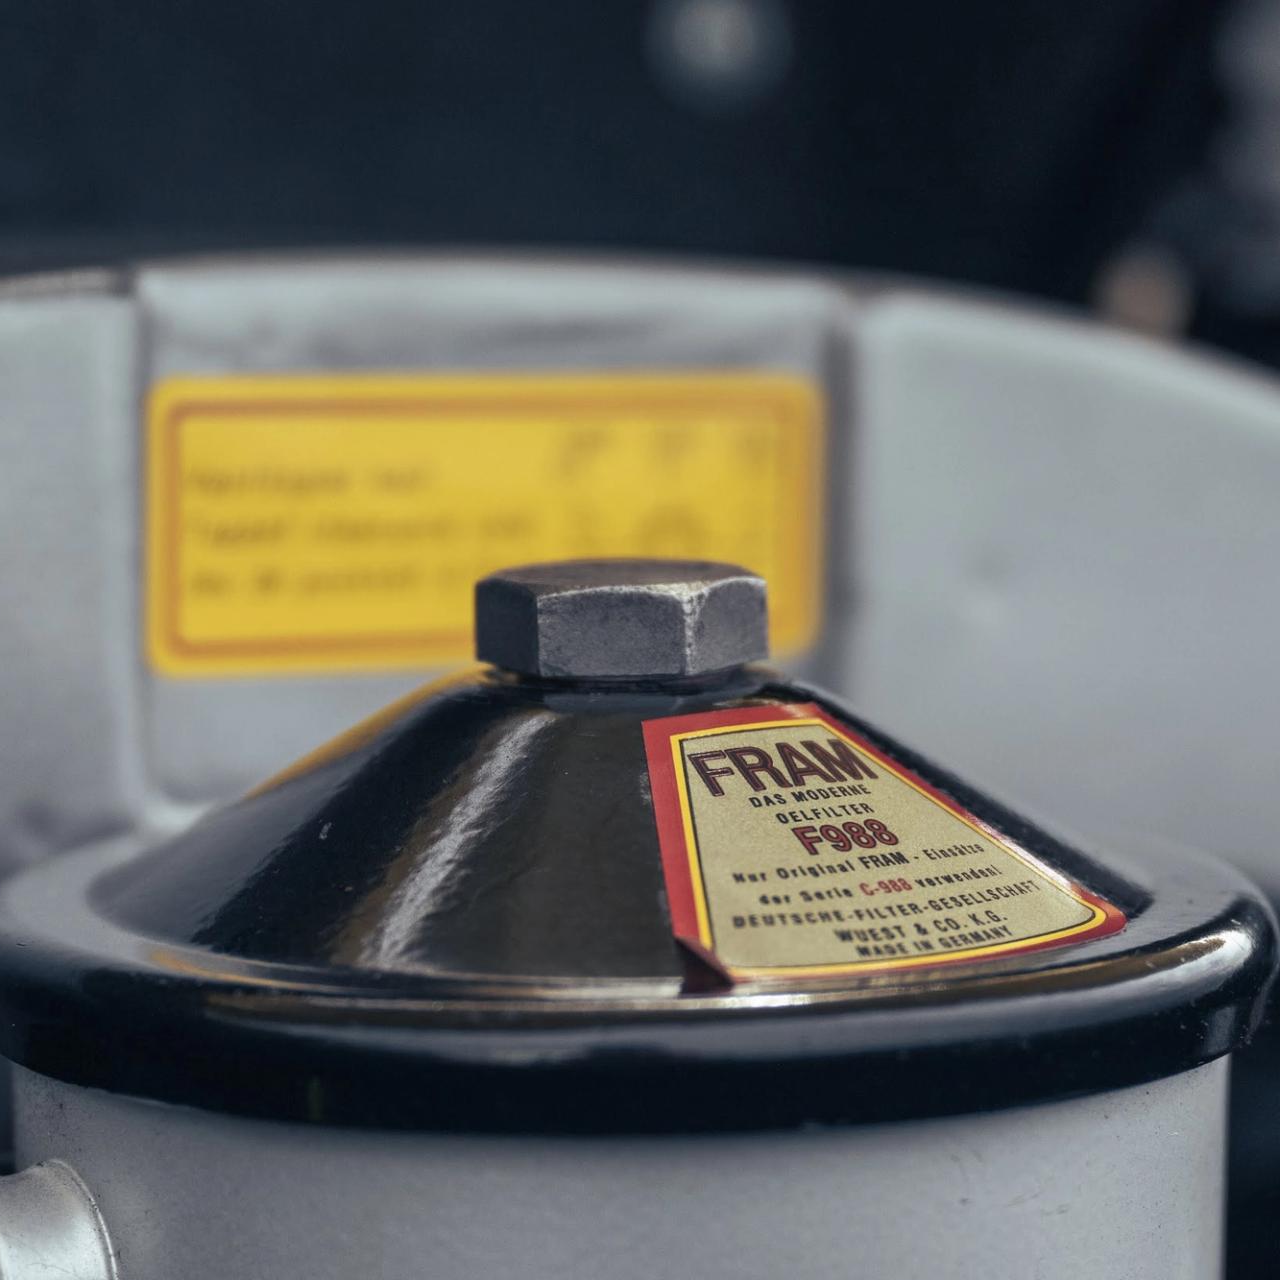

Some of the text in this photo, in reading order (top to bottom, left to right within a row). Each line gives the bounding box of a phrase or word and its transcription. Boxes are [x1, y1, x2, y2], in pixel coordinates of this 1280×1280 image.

[688, 739, 879, 797] FRAM
[749, 784, 872, 808] DAS MODERNE
[776, 802, 875, 825] OELFILTER
[791, 818, 899, 855] F988
[776, 859, 856, 880] Original
[858, 851, 910, 870] FRAM
[922, 843, 985, 861] Einsätze
[799, 887, 854, 903] Serie
[859, 878, 913, 897] C-988
[834, 924, 906, 942] WUEST
[913, 923, 929, 936] &
[933, 917, 968, 933] CO.
[855, 925, 1013, 957] MADE IN GERMANY
